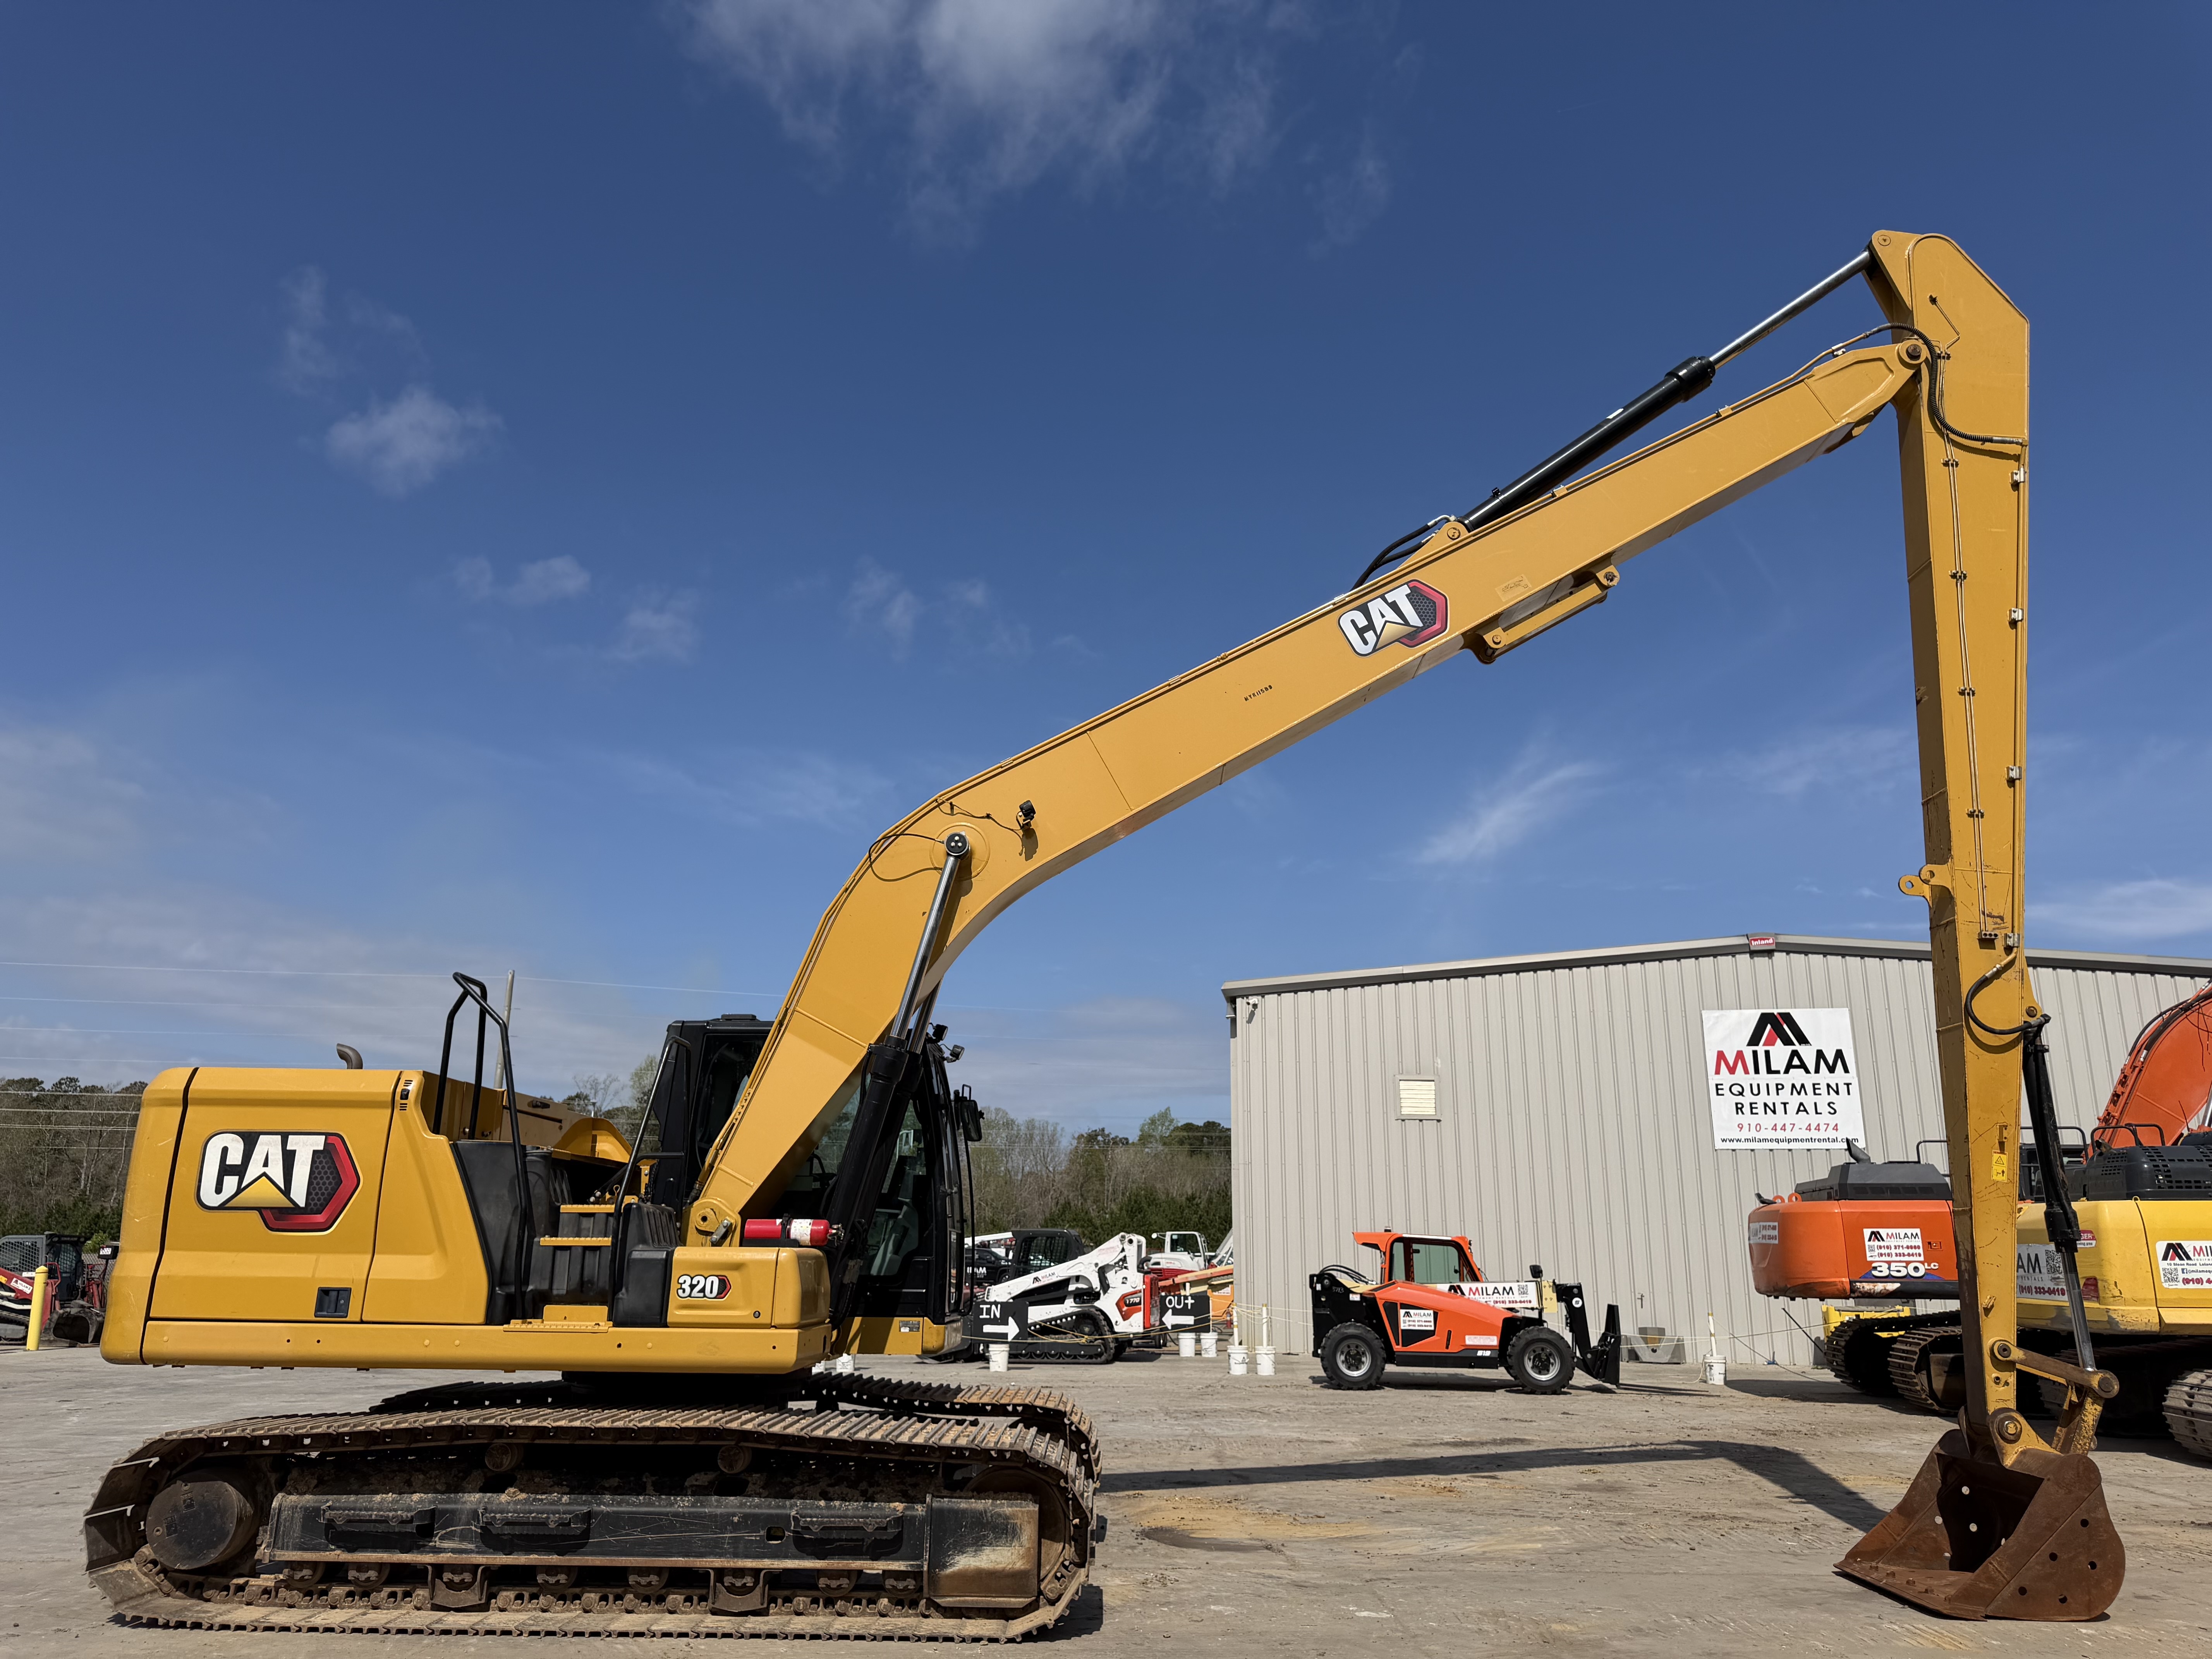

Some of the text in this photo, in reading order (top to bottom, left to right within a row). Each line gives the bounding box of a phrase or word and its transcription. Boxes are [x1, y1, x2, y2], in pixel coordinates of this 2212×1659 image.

[1340, 584, 1424, 654] CAT
[1714, 1049, 1850, 1075] MILAM
[1715, 1083, 1852, 1097] EQUIPMENT
[1735, 1102, 1837, 1115] RENTALS
[1737, 1123, 1839, 1132] 910-447-4474
[200, 1133, 325, 1207] CAT
[678, 1275, 719, 1298] 320
[1468, 1286, 1515, 1296] MILAM
[979, 1304, 1001, 1318] IN
